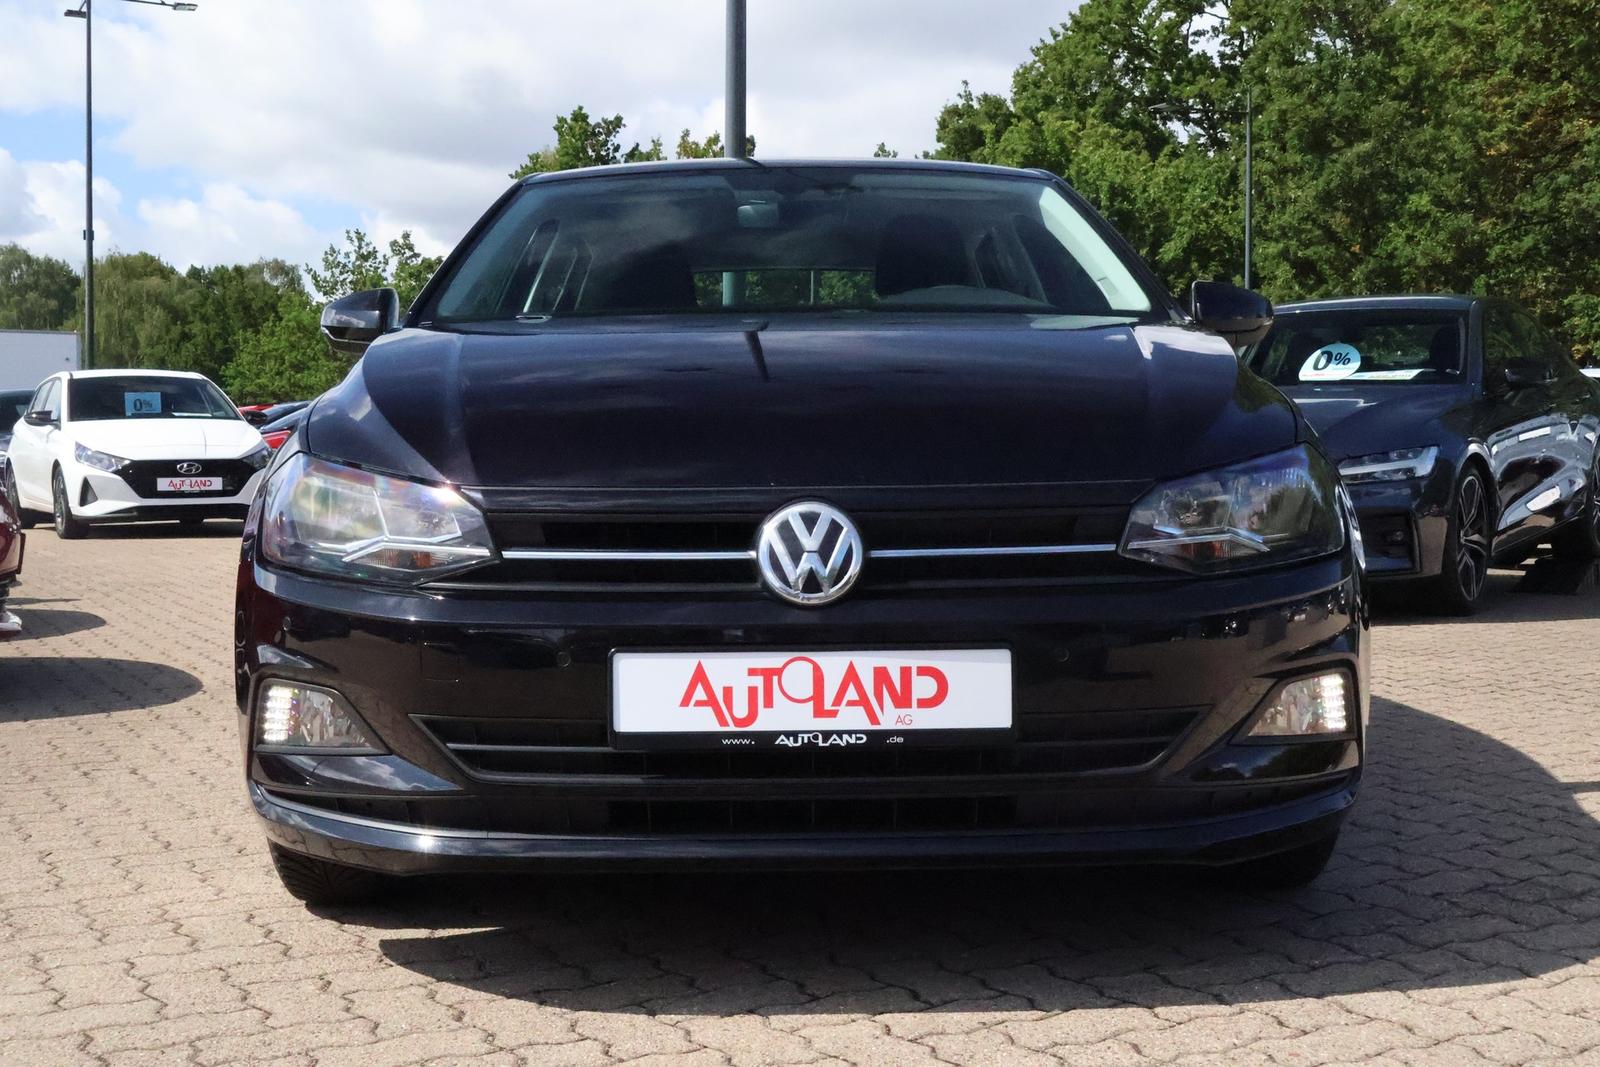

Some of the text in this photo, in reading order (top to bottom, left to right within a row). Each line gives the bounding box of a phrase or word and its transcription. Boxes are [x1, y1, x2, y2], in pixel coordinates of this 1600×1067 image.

[1313, 350, 1351, 371] 0%
[760, 505, 860, 601] VW
[679, 656, 949, 729] AUTOLAND
[894, 714, 914, 726] AG
[721, 737, 756, 746] www.
[886, 735, 905, 744] .de
